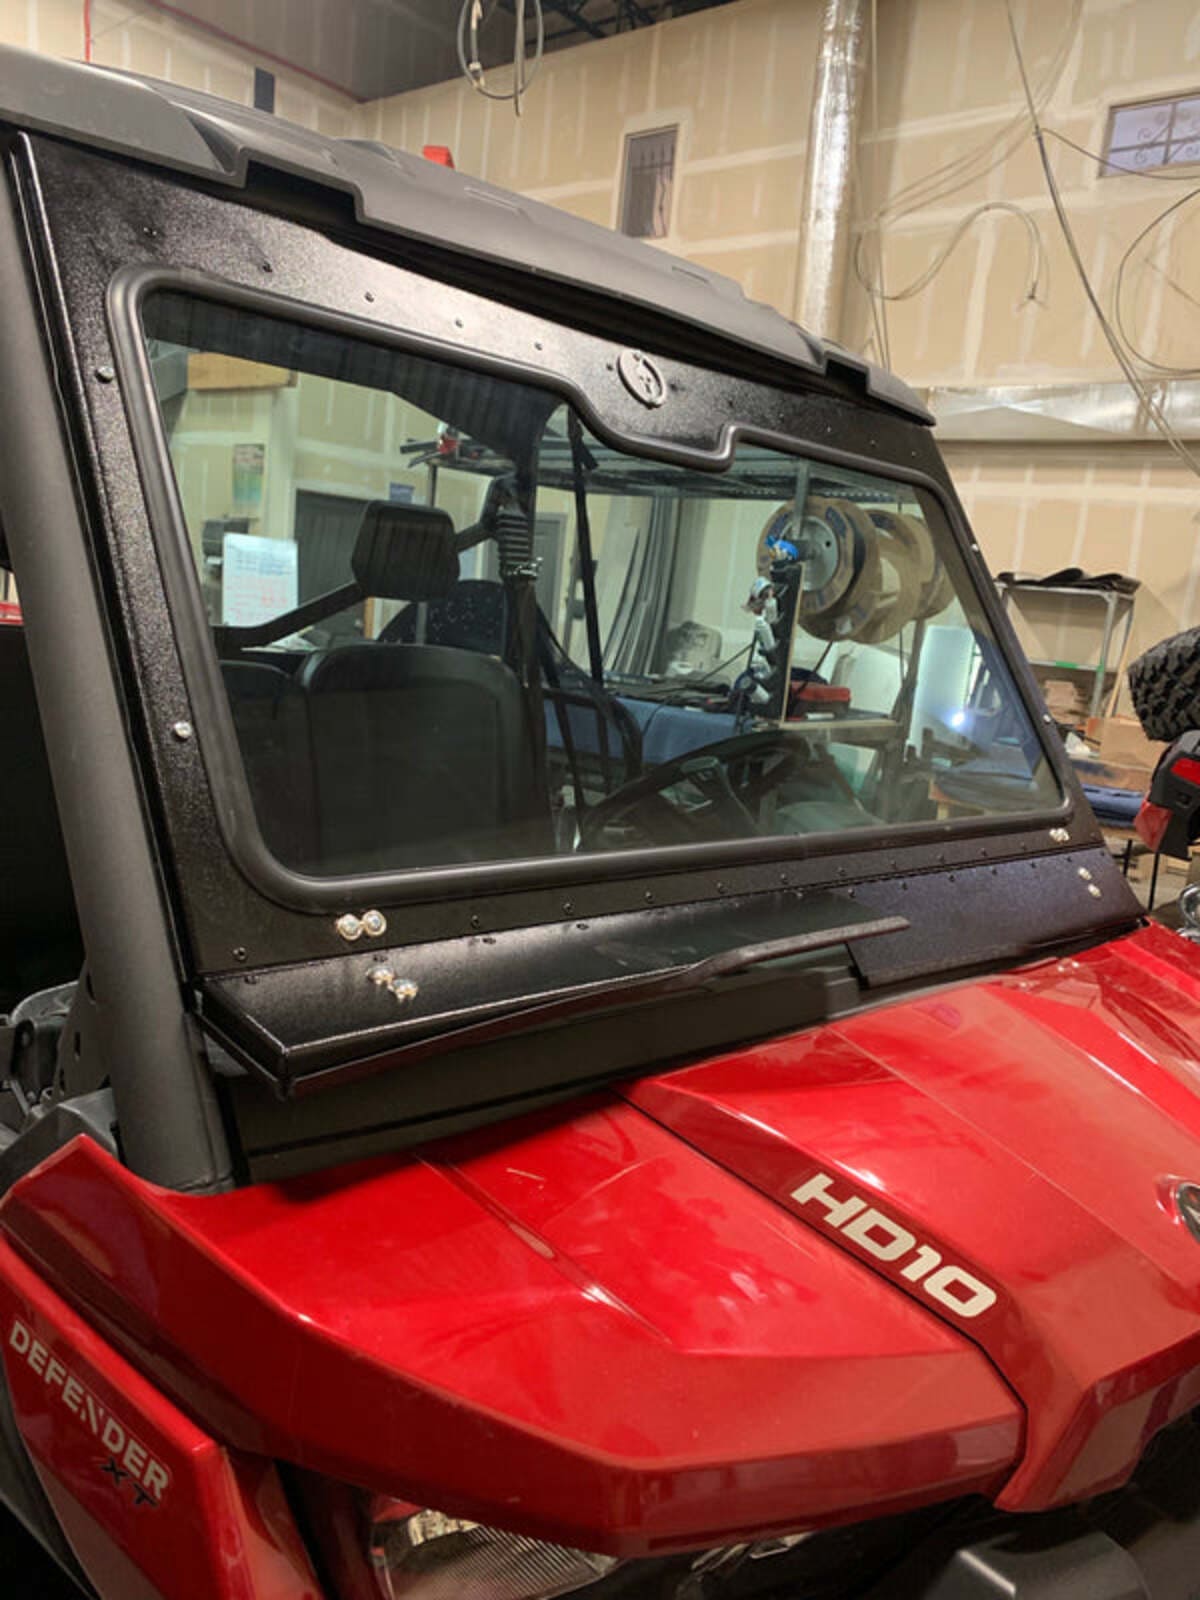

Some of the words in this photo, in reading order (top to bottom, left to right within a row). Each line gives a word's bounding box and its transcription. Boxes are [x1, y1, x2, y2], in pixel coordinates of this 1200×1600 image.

[791, 1173, 997, 1318] HD10
[9, 1321, 170, 1498] DEFENDER
[102, 1458, 159, 1507] XT
